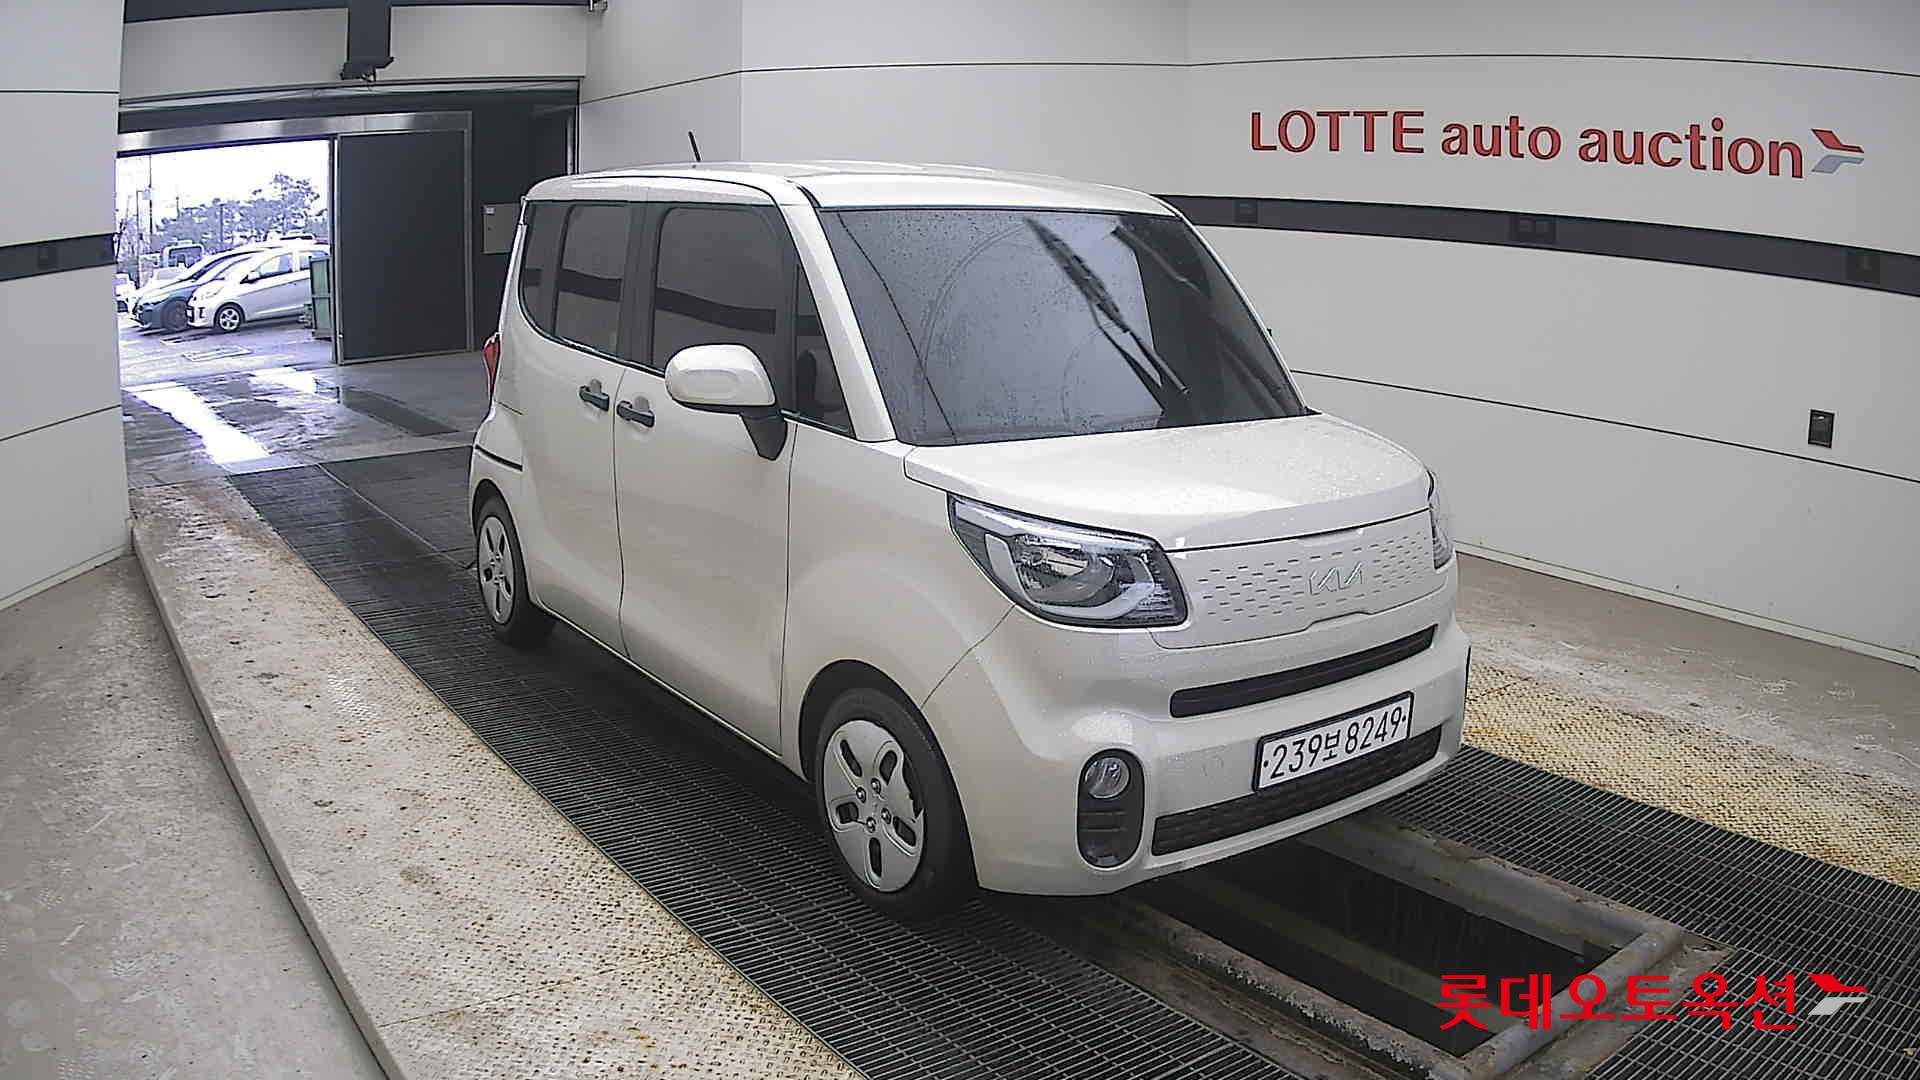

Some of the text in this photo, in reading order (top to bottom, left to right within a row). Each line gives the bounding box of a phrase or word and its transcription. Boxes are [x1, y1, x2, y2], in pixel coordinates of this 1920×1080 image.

[1251, 110, 1804, 178] LOTTE auto auction
